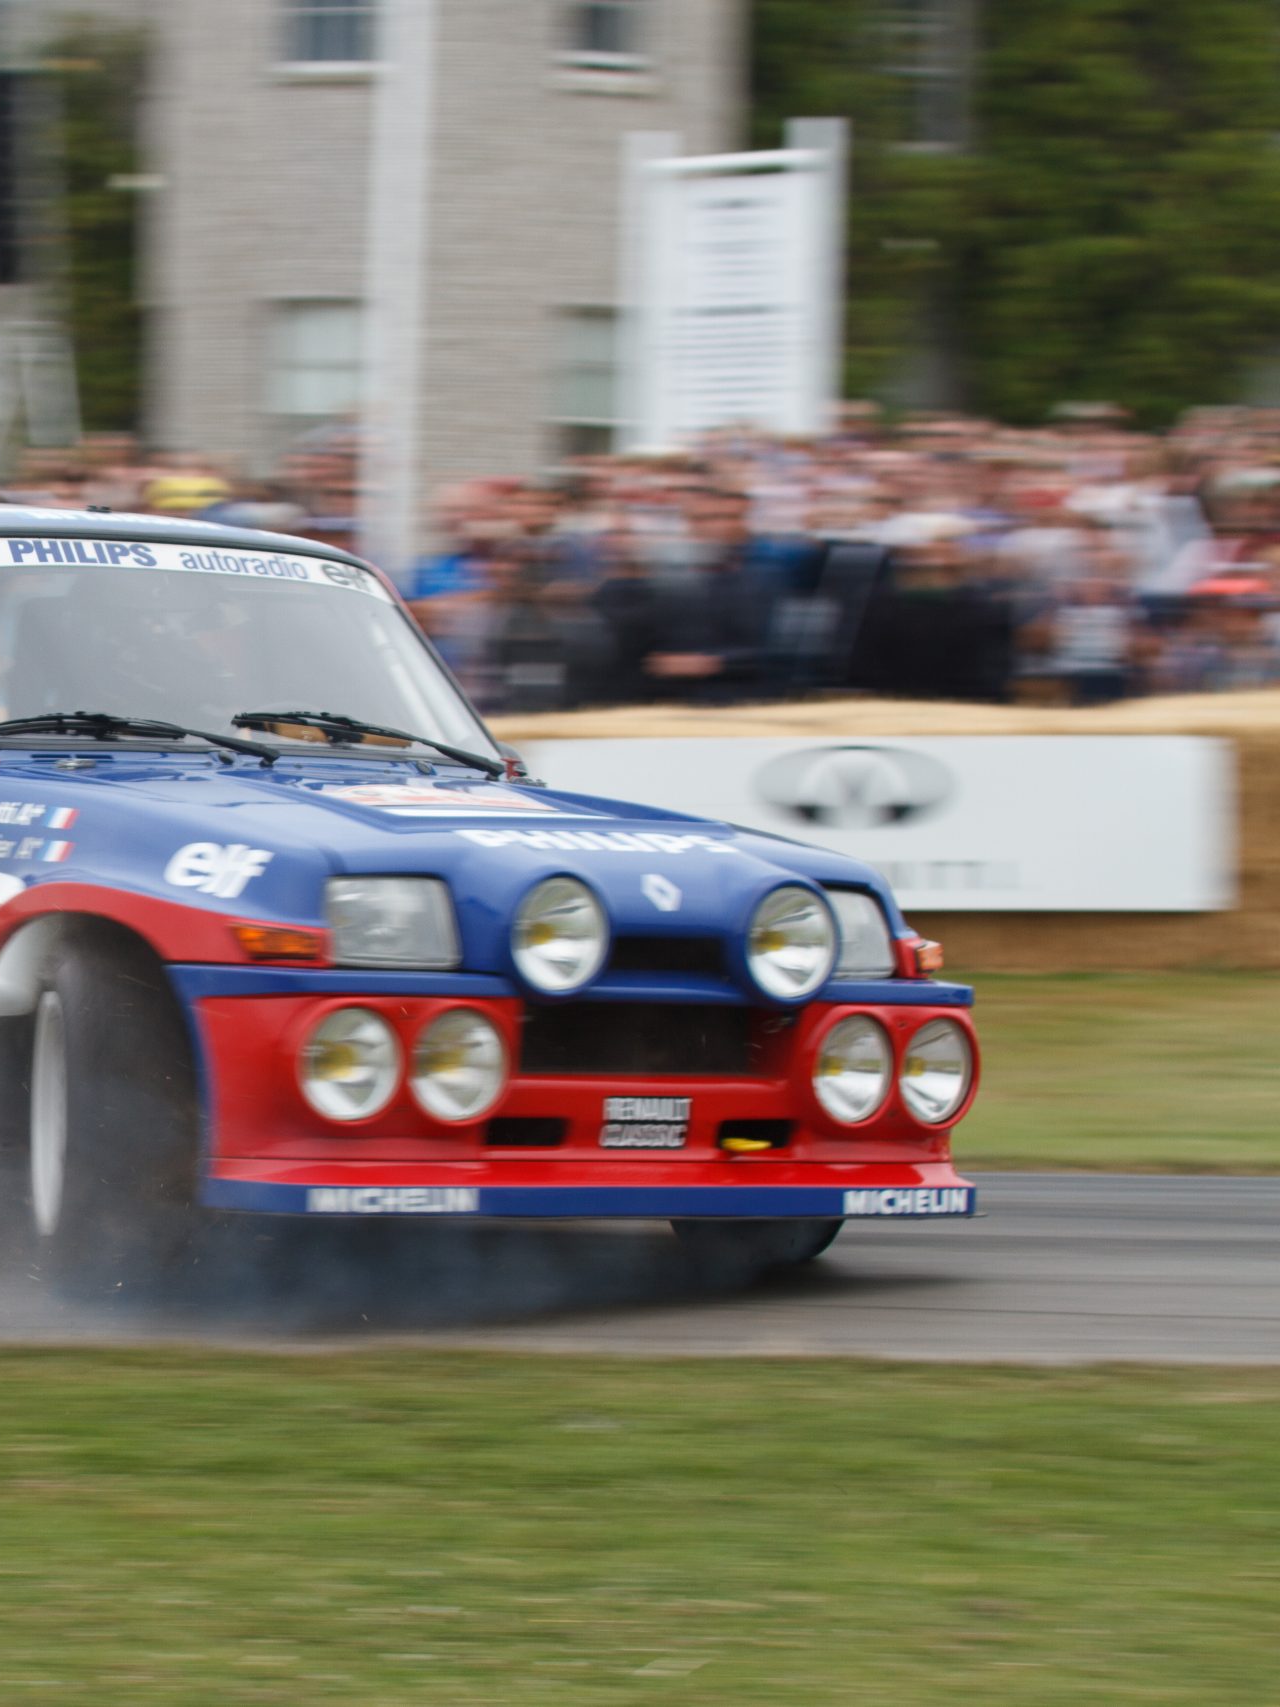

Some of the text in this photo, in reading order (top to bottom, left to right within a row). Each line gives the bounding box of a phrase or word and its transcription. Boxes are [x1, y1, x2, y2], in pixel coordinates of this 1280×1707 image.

[10, 540, 158, 567] PHILIPS
[181, 550, 309, 580] autoradio
[456, 829, 737, 854] PHILIPS
[164, 842, 274, 899] elf
[308, 1187, 968, 1214] MICHELIN MICHELIN
